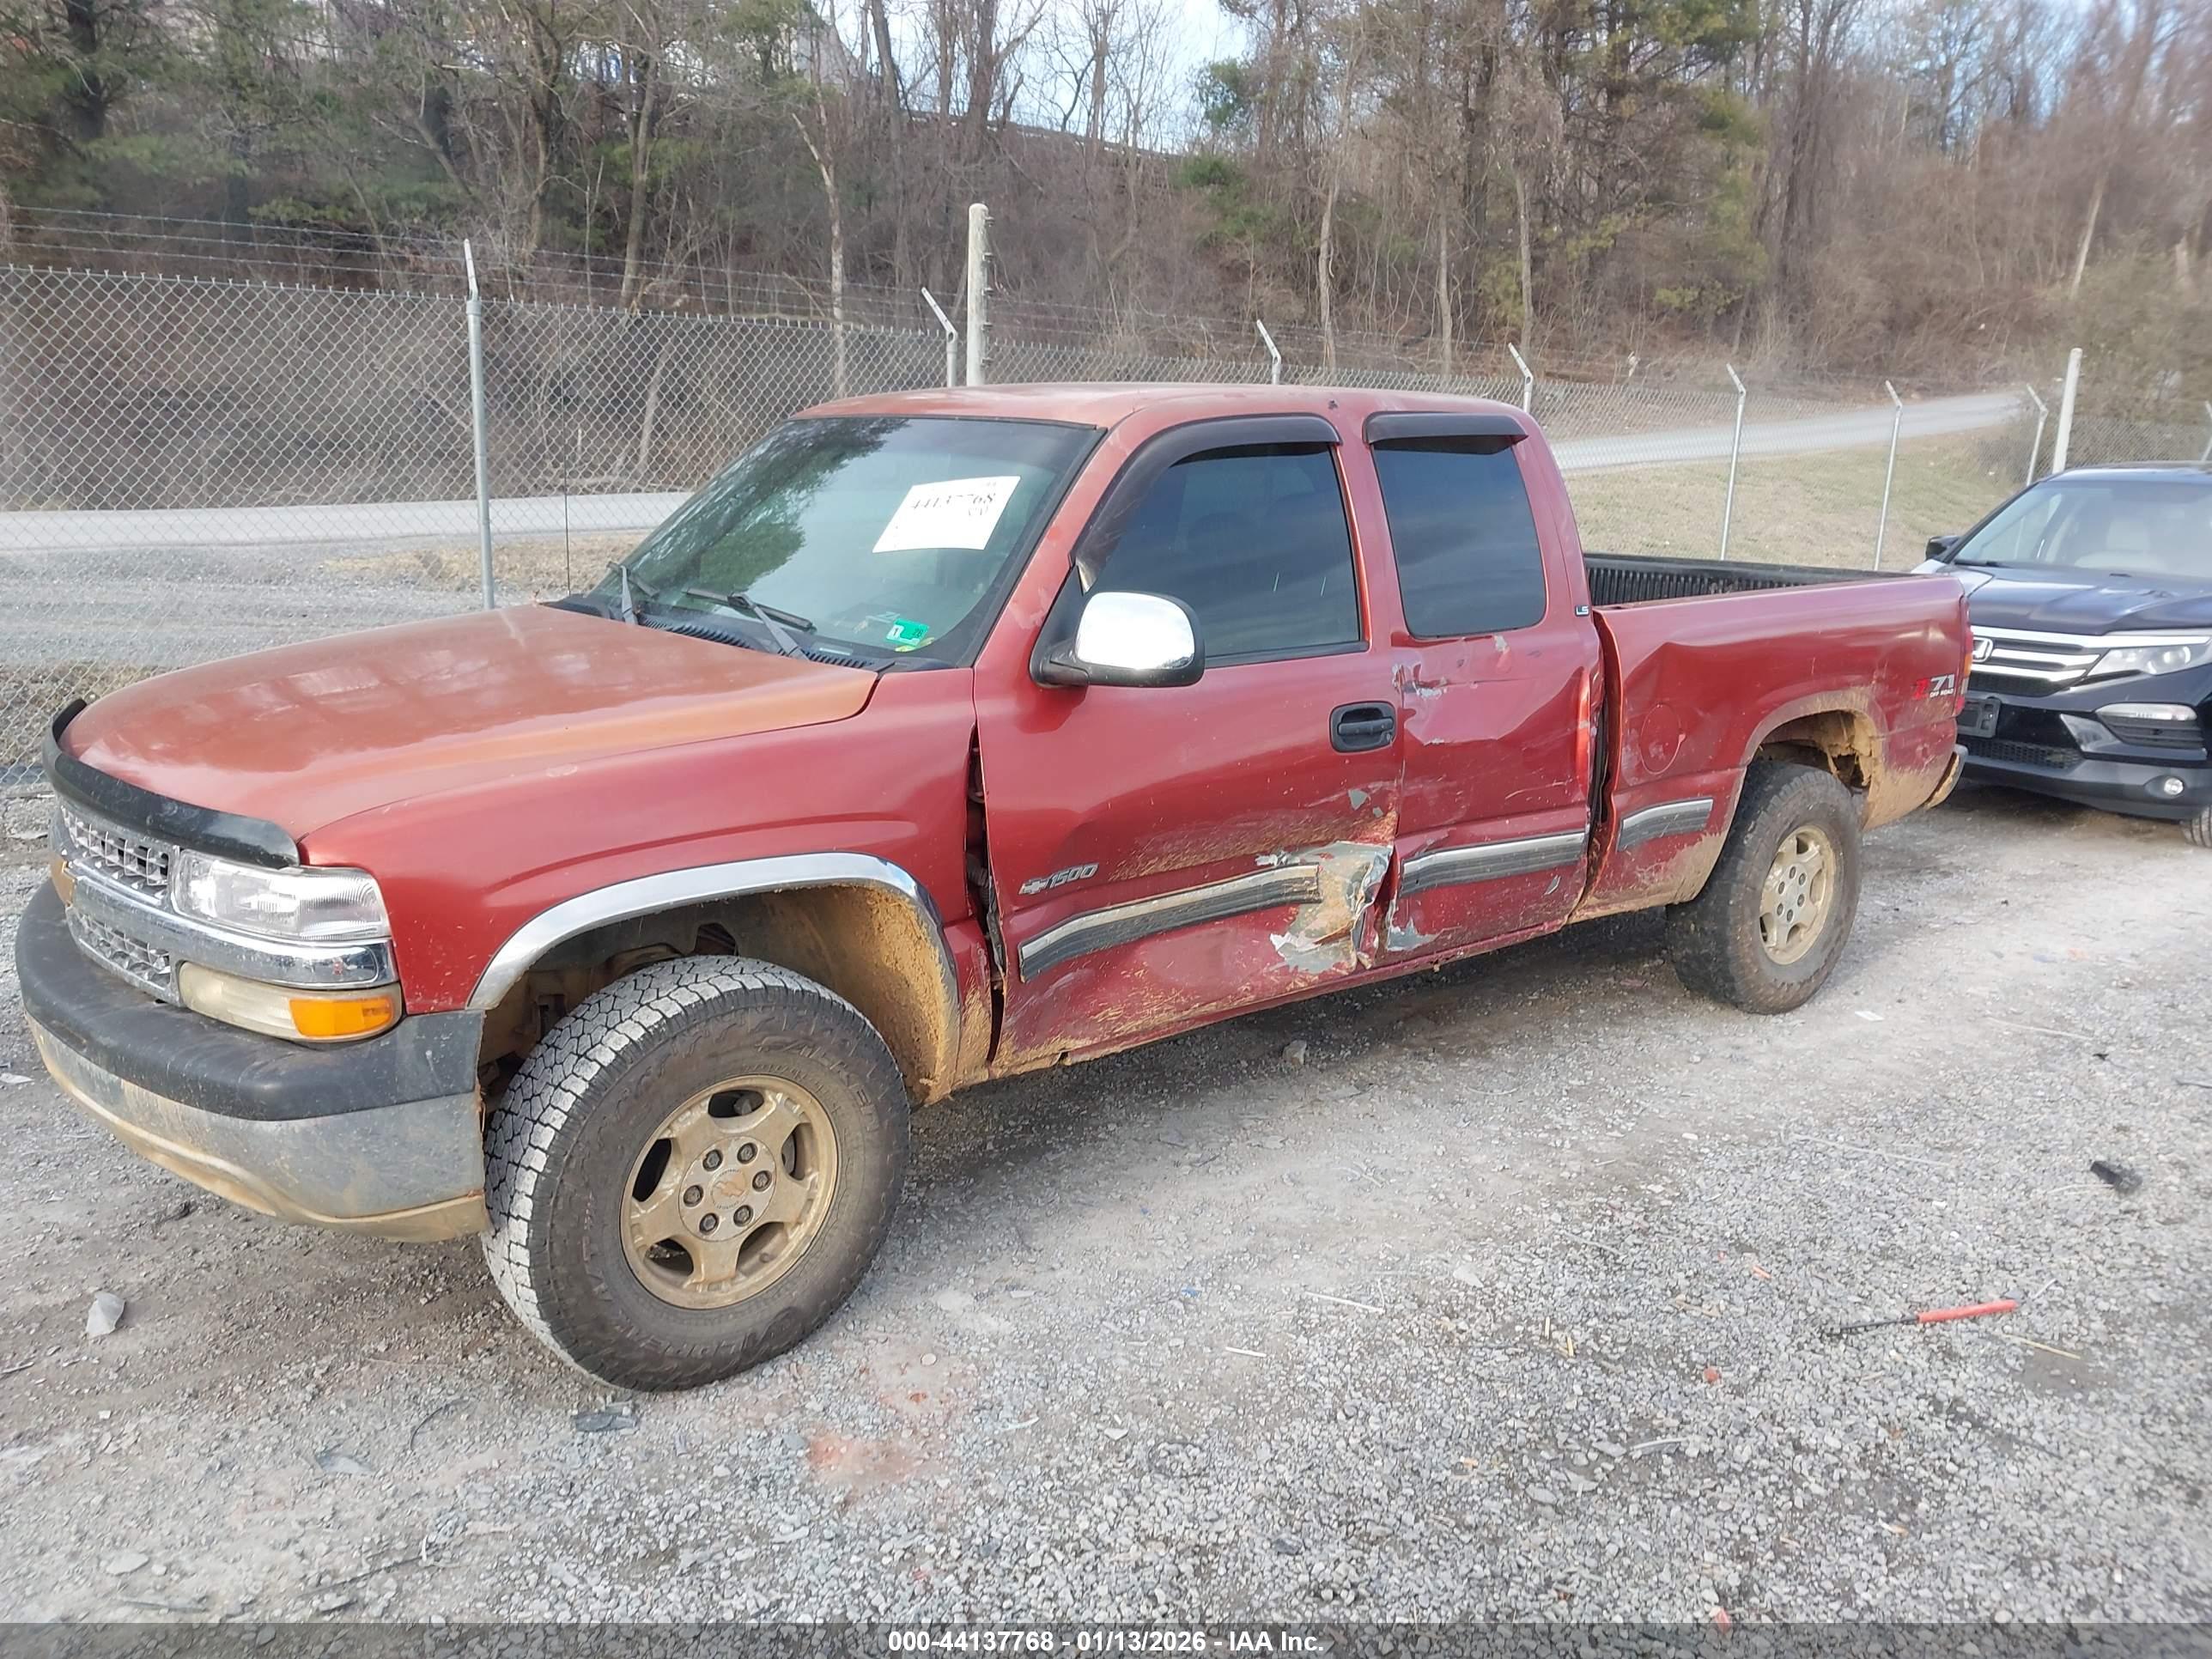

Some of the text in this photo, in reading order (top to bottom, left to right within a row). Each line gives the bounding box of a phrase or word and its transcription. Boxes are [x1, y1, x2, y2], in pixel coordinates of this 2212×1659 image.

[1576, 605, 1589, 616] LS
[1913, 674, 1954, 699] Z71
[1048, 864, 1098, 890] 1500
